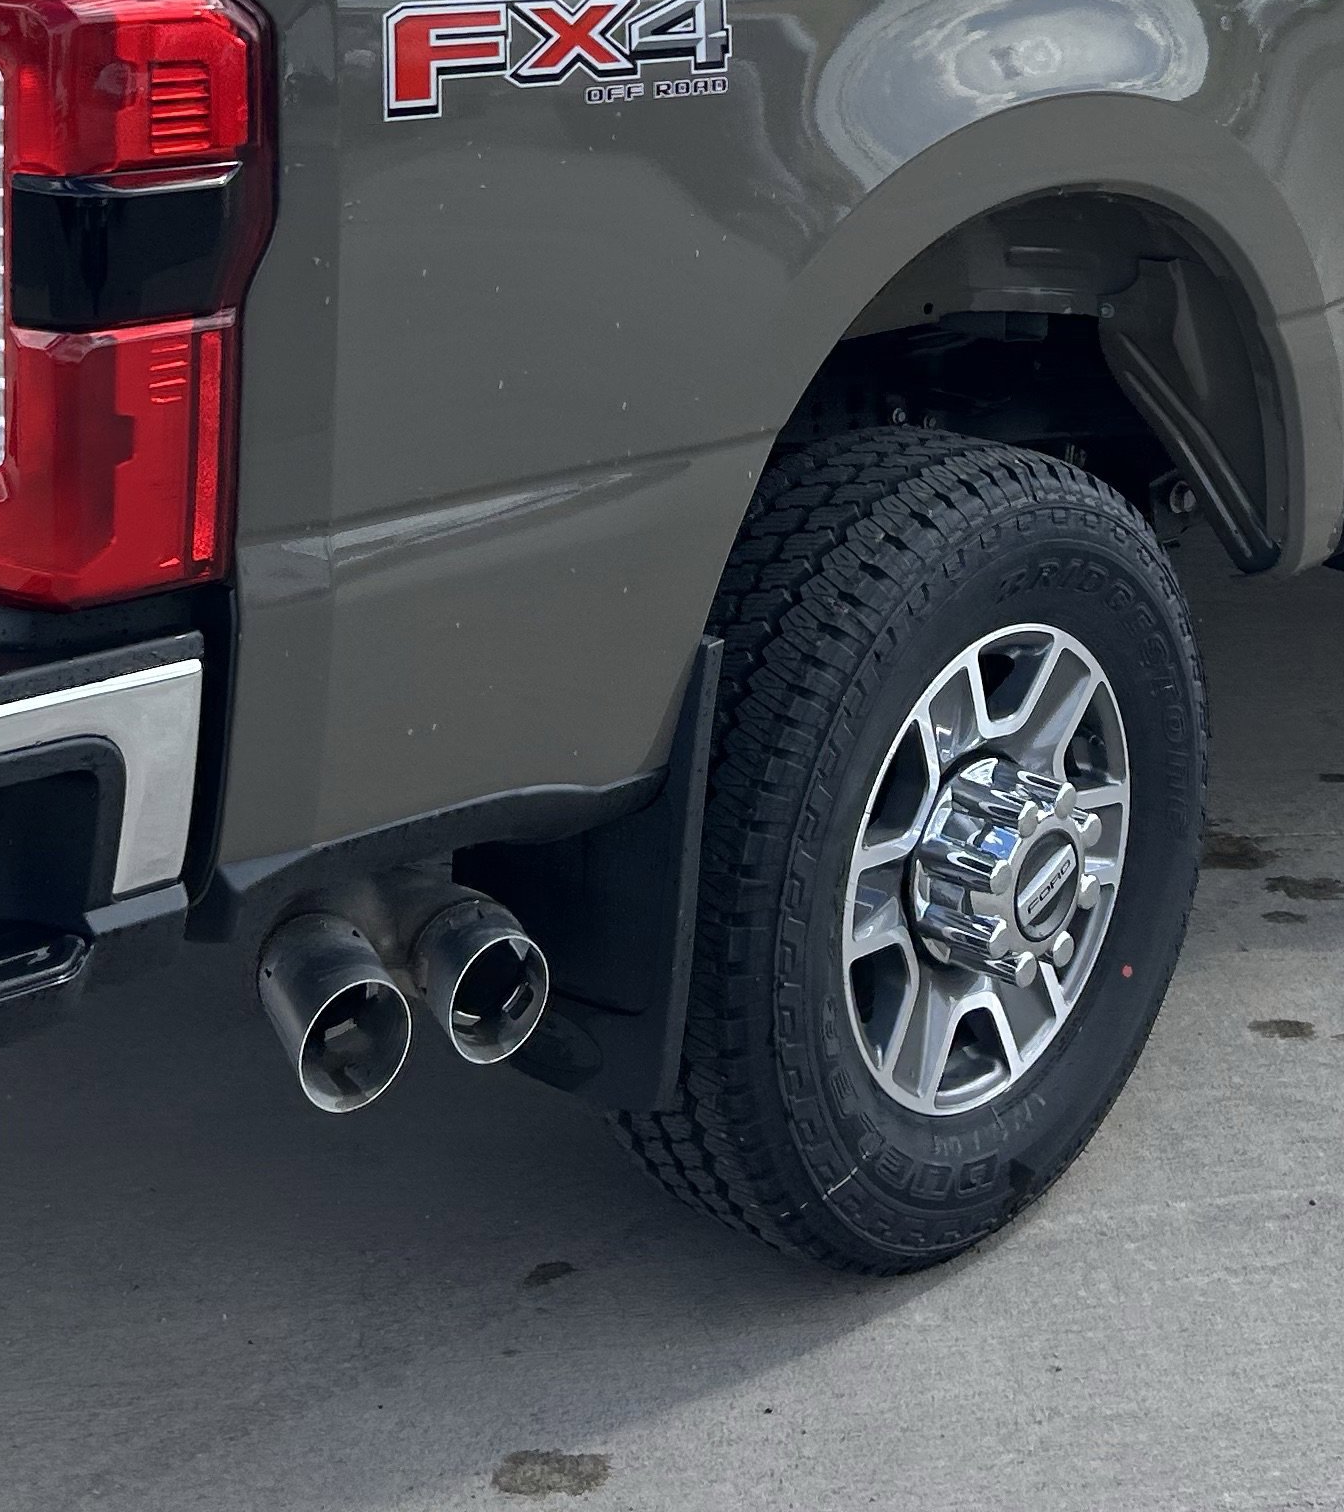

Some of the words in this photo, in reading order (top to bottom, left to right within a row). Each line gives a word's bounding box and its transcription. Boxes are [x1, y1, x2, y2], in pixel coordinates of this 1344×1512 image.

[584, 82, 644, 105] OFF
[653, 76, 729, 100] ROAD
[1026, 858, 1072, 915] FORD
